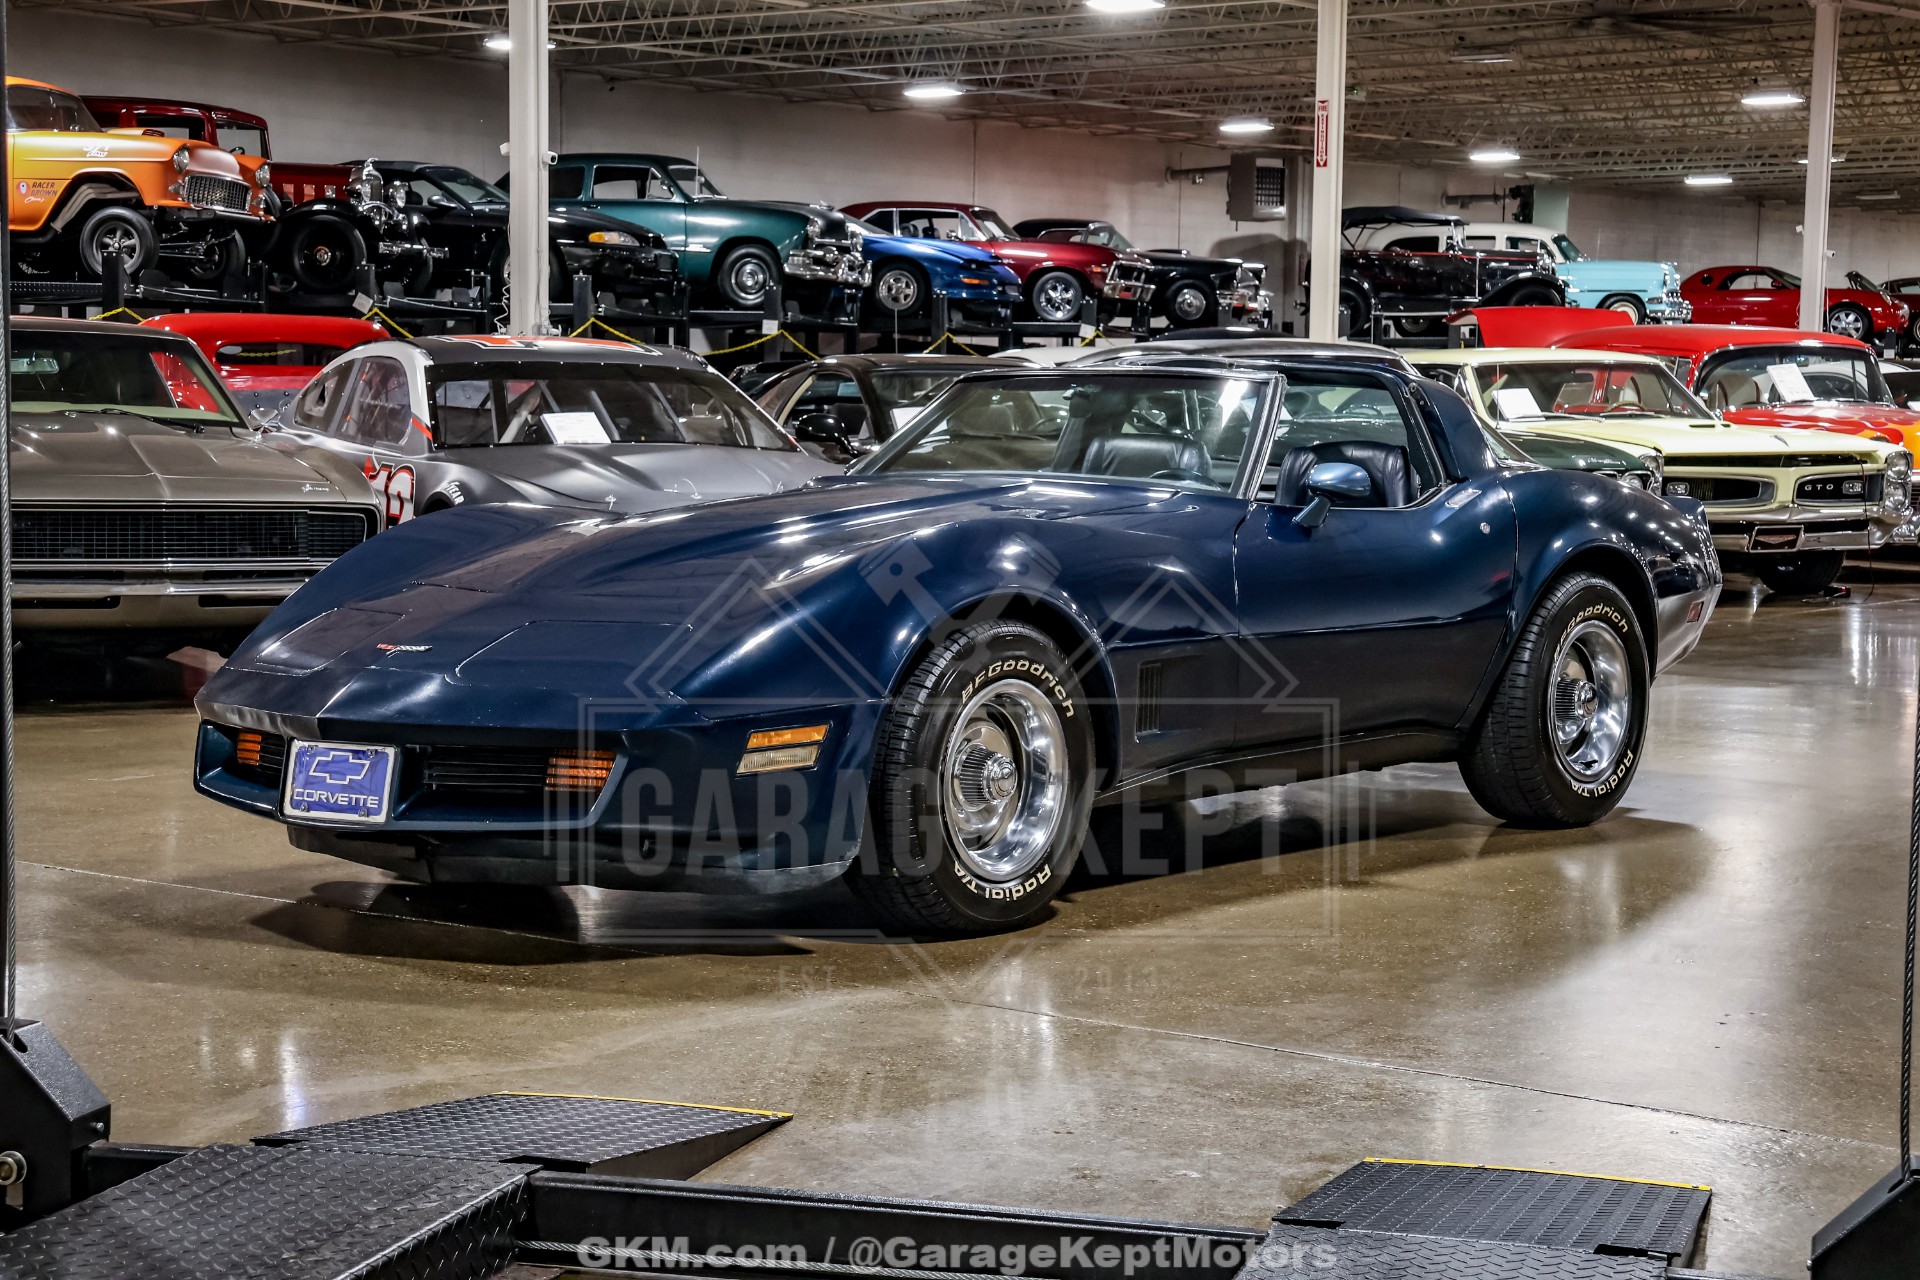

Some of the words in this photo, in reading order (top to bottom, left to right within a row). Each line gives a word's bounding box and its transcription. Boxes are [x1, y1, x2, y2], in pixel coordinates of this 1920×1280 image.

[31, 181, 56, 189] RACER
[31, 189, 58, 197] BROWN
[1804, 483, 1835, 492] GTO
[961, 658, 1075, 718] BFGoodrich
[1593, 748, 1634, 798] Radial
[293, 788, 380, 808] CORVETTE
[953, 859, 978, 894] T/A
[984, 863, 1053, 902] Radial
